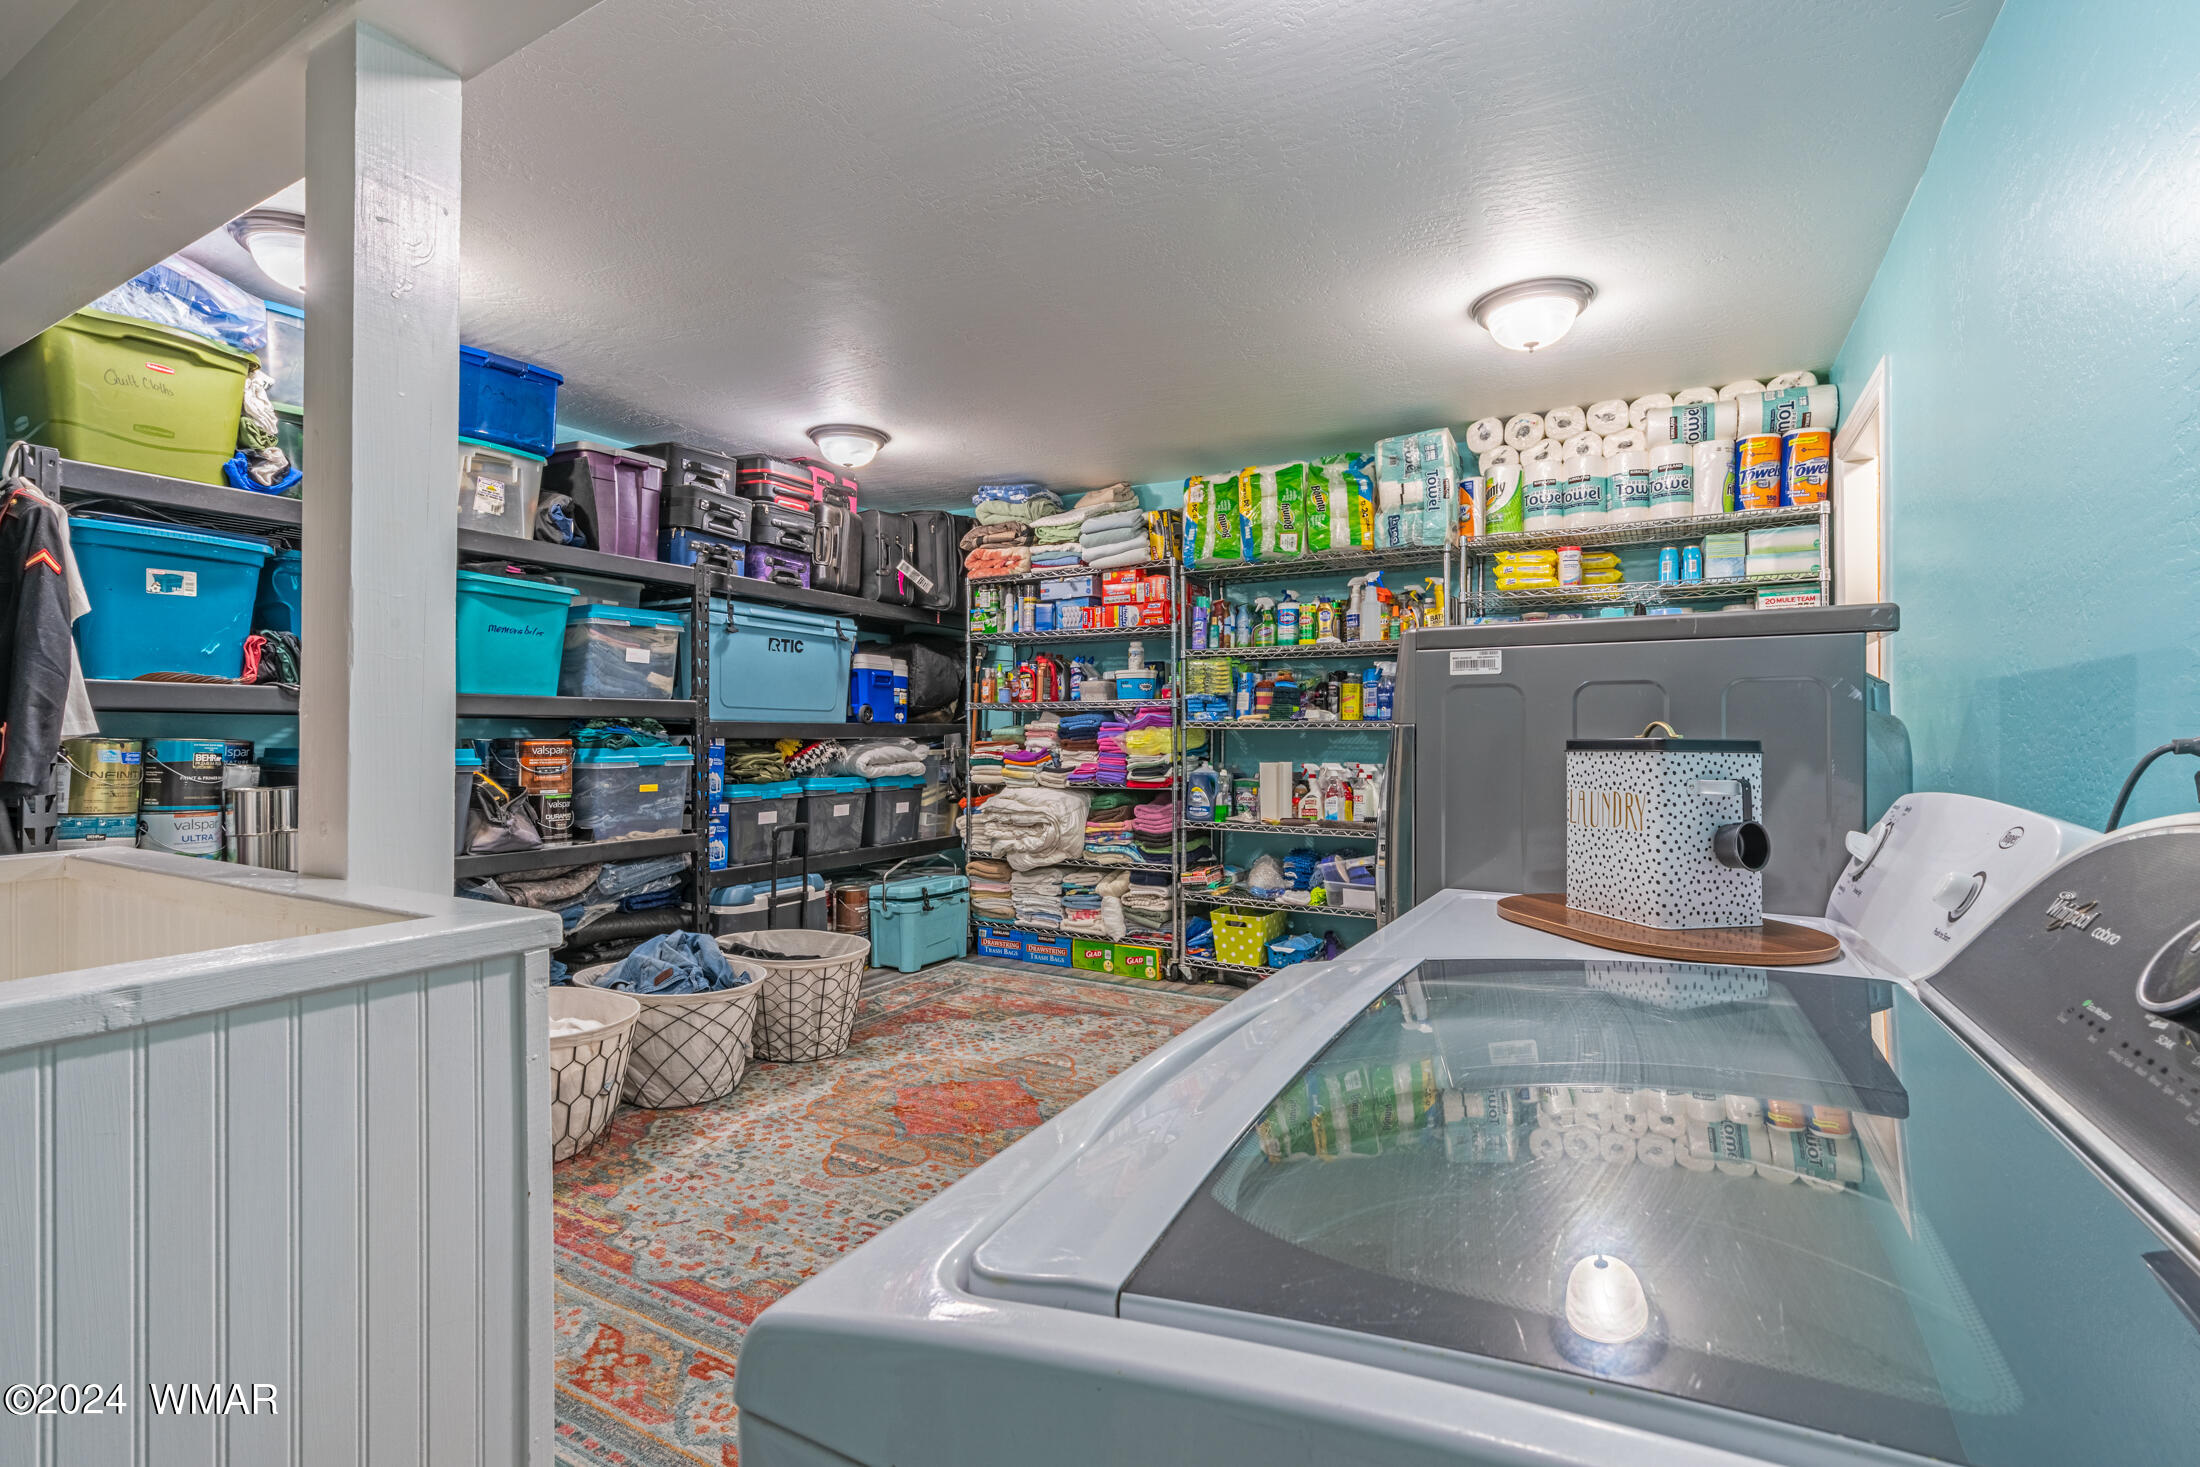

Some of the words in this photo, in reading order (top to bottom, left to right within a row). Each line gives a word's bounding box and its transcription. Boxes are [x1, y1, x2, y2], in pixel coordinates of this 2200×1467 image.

[1427, 469, 1440, 513] Towel
[1311, 486, 1325, 512] Bounty
[1281, 503, 1294, 530] Bounty
[1218, 514, 1231, 538] Bounty
[768, 637, 804, 654] RTIC
[532, 745, 564, 757] valspar
[1569, 788, 1646, 832] LAUNDRY
[174, 818, 218, 831] valspar
[182, 834, 214, 842] ULTRA
[982, 938, 1020, 949] DRAWSTRING
[1028, 944, 1066, 955] DRAWSTRING
[1085, 950, 1102, 958] GLAD
[1127, 956, 1144, 965] GLAD
